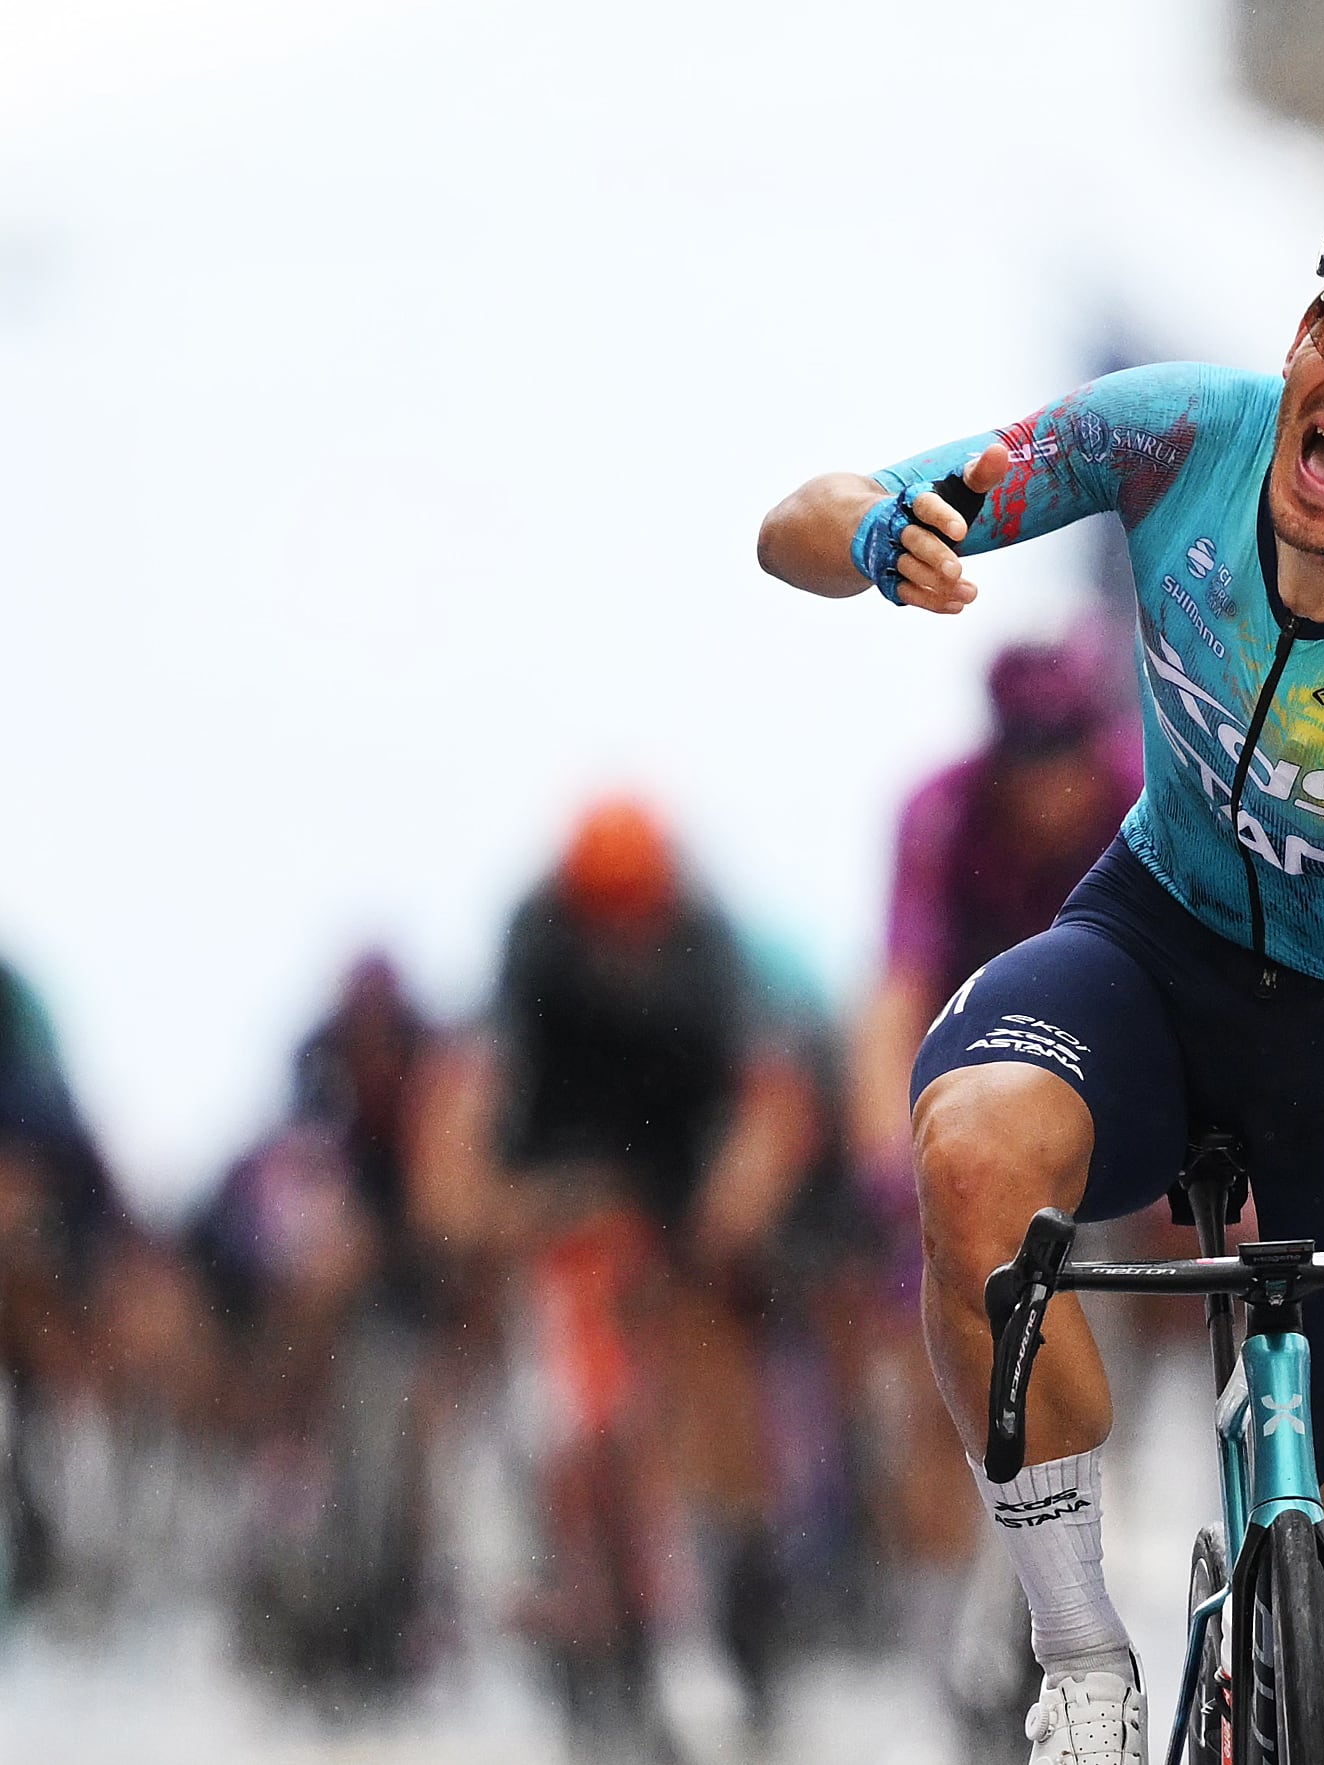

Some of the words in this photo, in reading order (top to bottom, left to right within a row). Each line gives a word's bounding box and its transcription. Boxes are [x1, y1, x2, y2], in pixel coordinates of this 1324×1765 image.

[1161, 573, 1226, 660] SHIMANO
[965, 1038, 1085, 1082] ASTANA
[1091, 1266, 1177, 1276] metron
